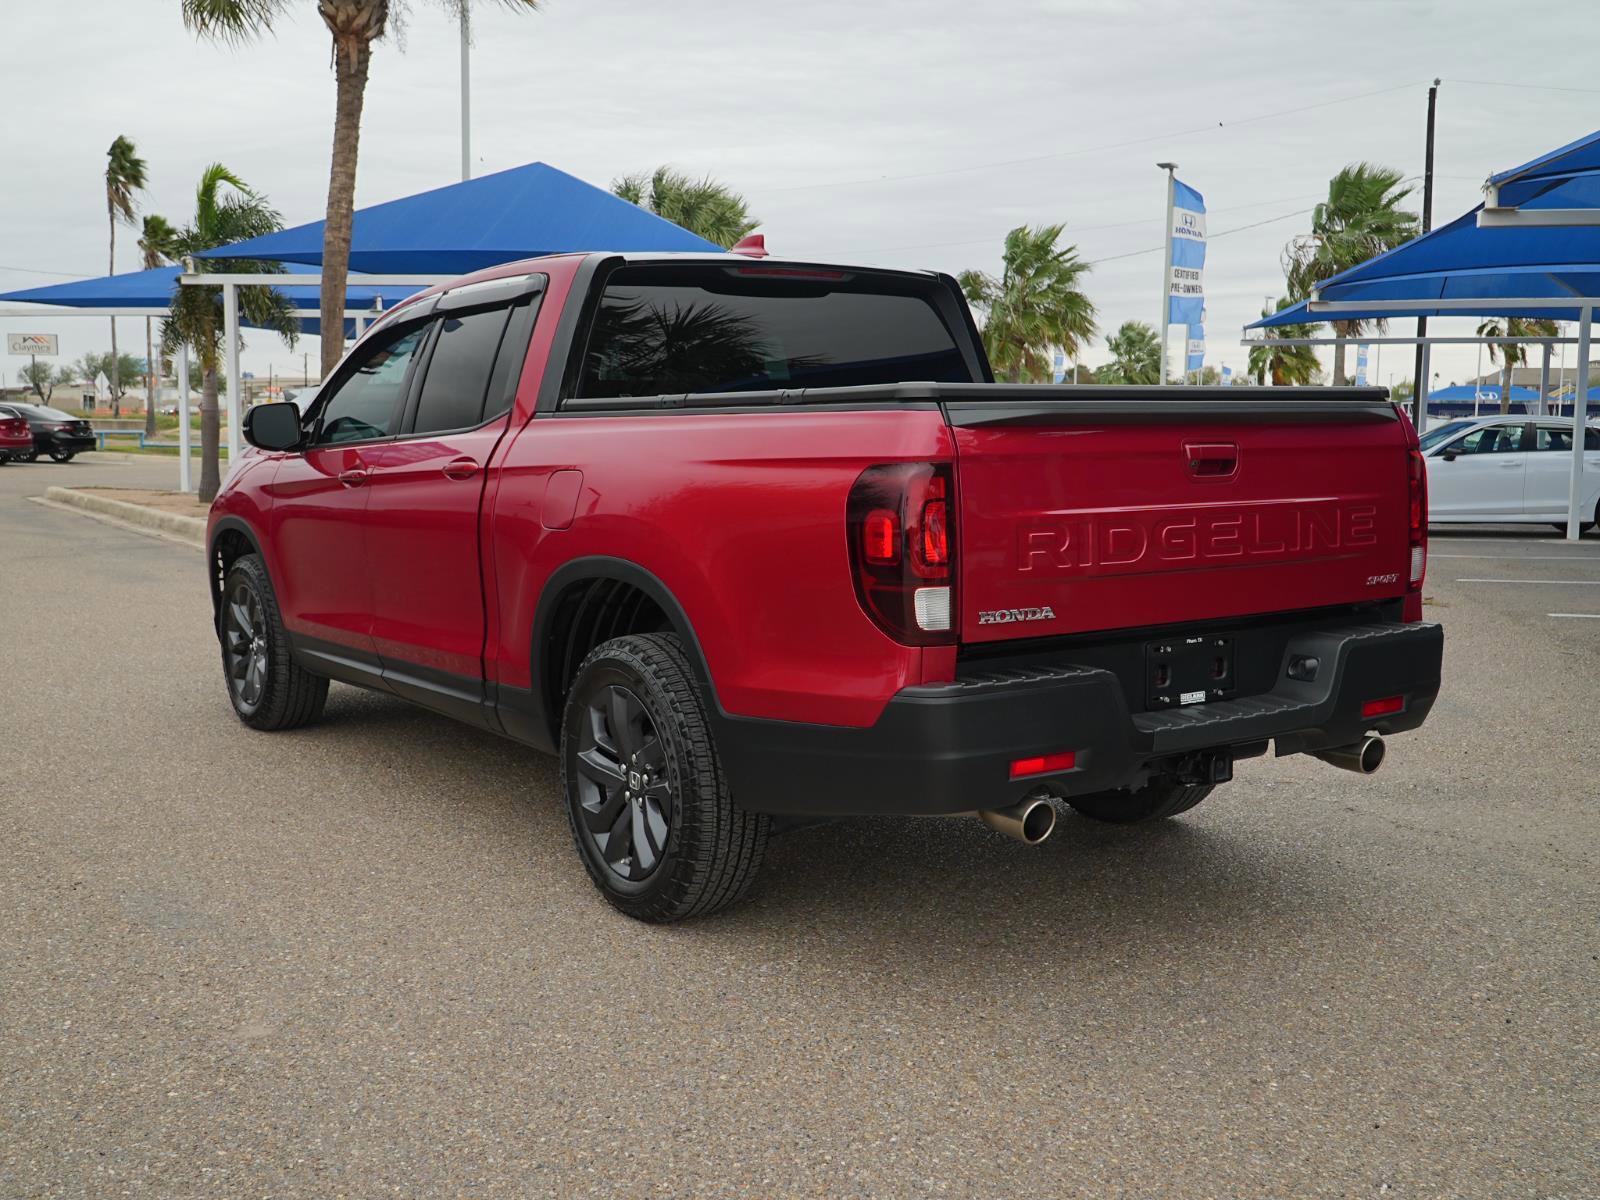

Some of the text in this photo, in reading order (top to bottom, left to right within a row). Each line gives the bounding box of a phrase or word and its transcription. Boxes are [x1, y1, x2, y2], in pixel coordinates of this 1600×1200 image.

[1175, 226, 1203, 238] HONDA
[1174, 268, 1199, 281] CERTIFIED
[1170, 282, 1203, 294] PRE-OWNED
[1016, 504, 1378, 572] RIDGELINE
[1366, 573, 1399, 585] SPORT
[978, 606, 1056, 625] HONDA
